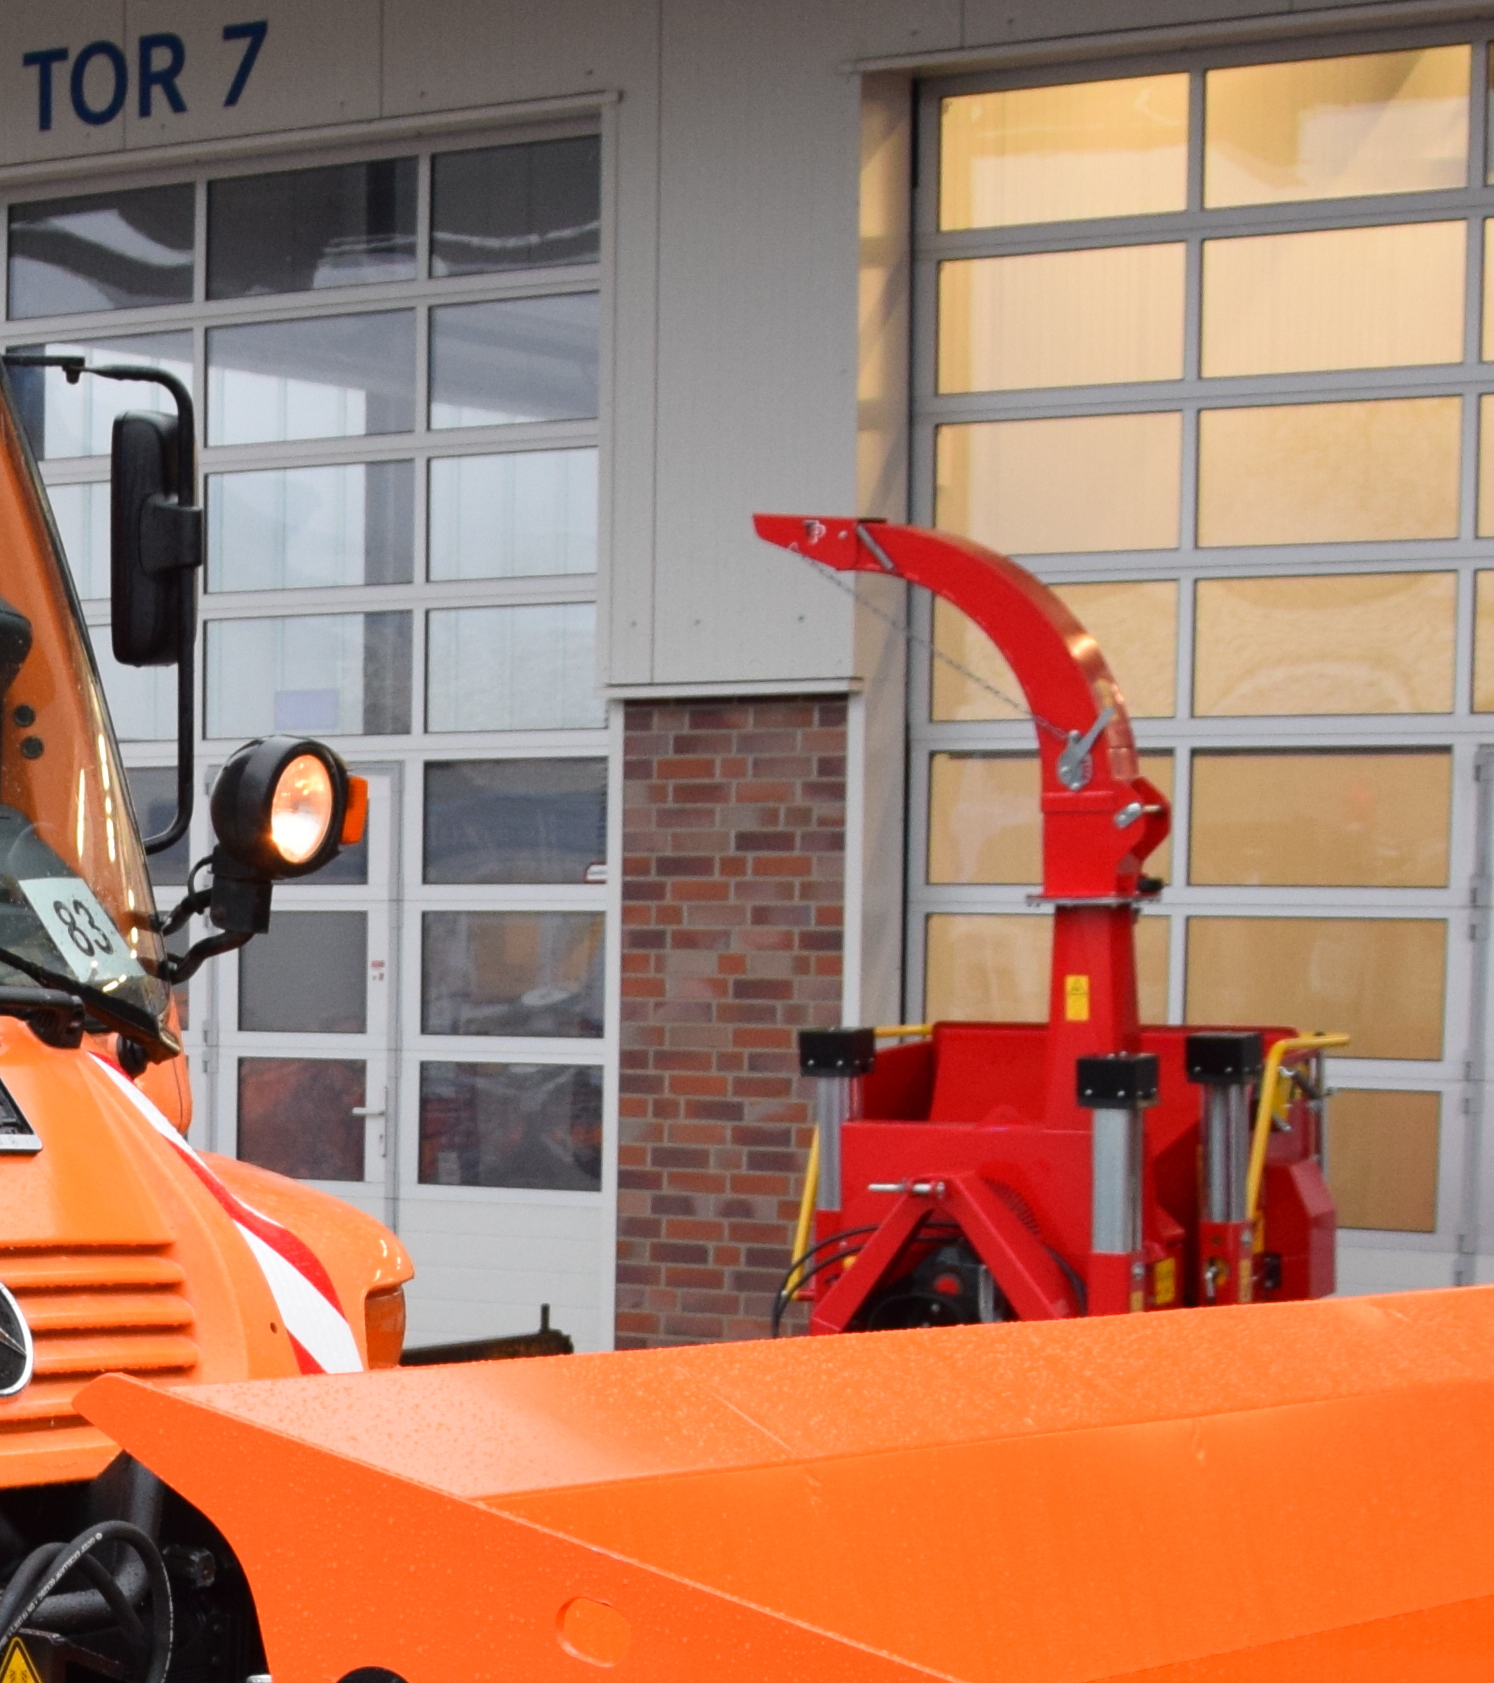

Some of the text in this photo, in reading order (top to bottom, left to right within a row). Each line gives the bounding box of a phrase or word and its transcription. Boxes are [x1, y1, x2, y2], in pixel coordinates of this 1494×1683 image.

[23, 20, 268, 132] TOR 7
[53, 899, 114, 957] 83
